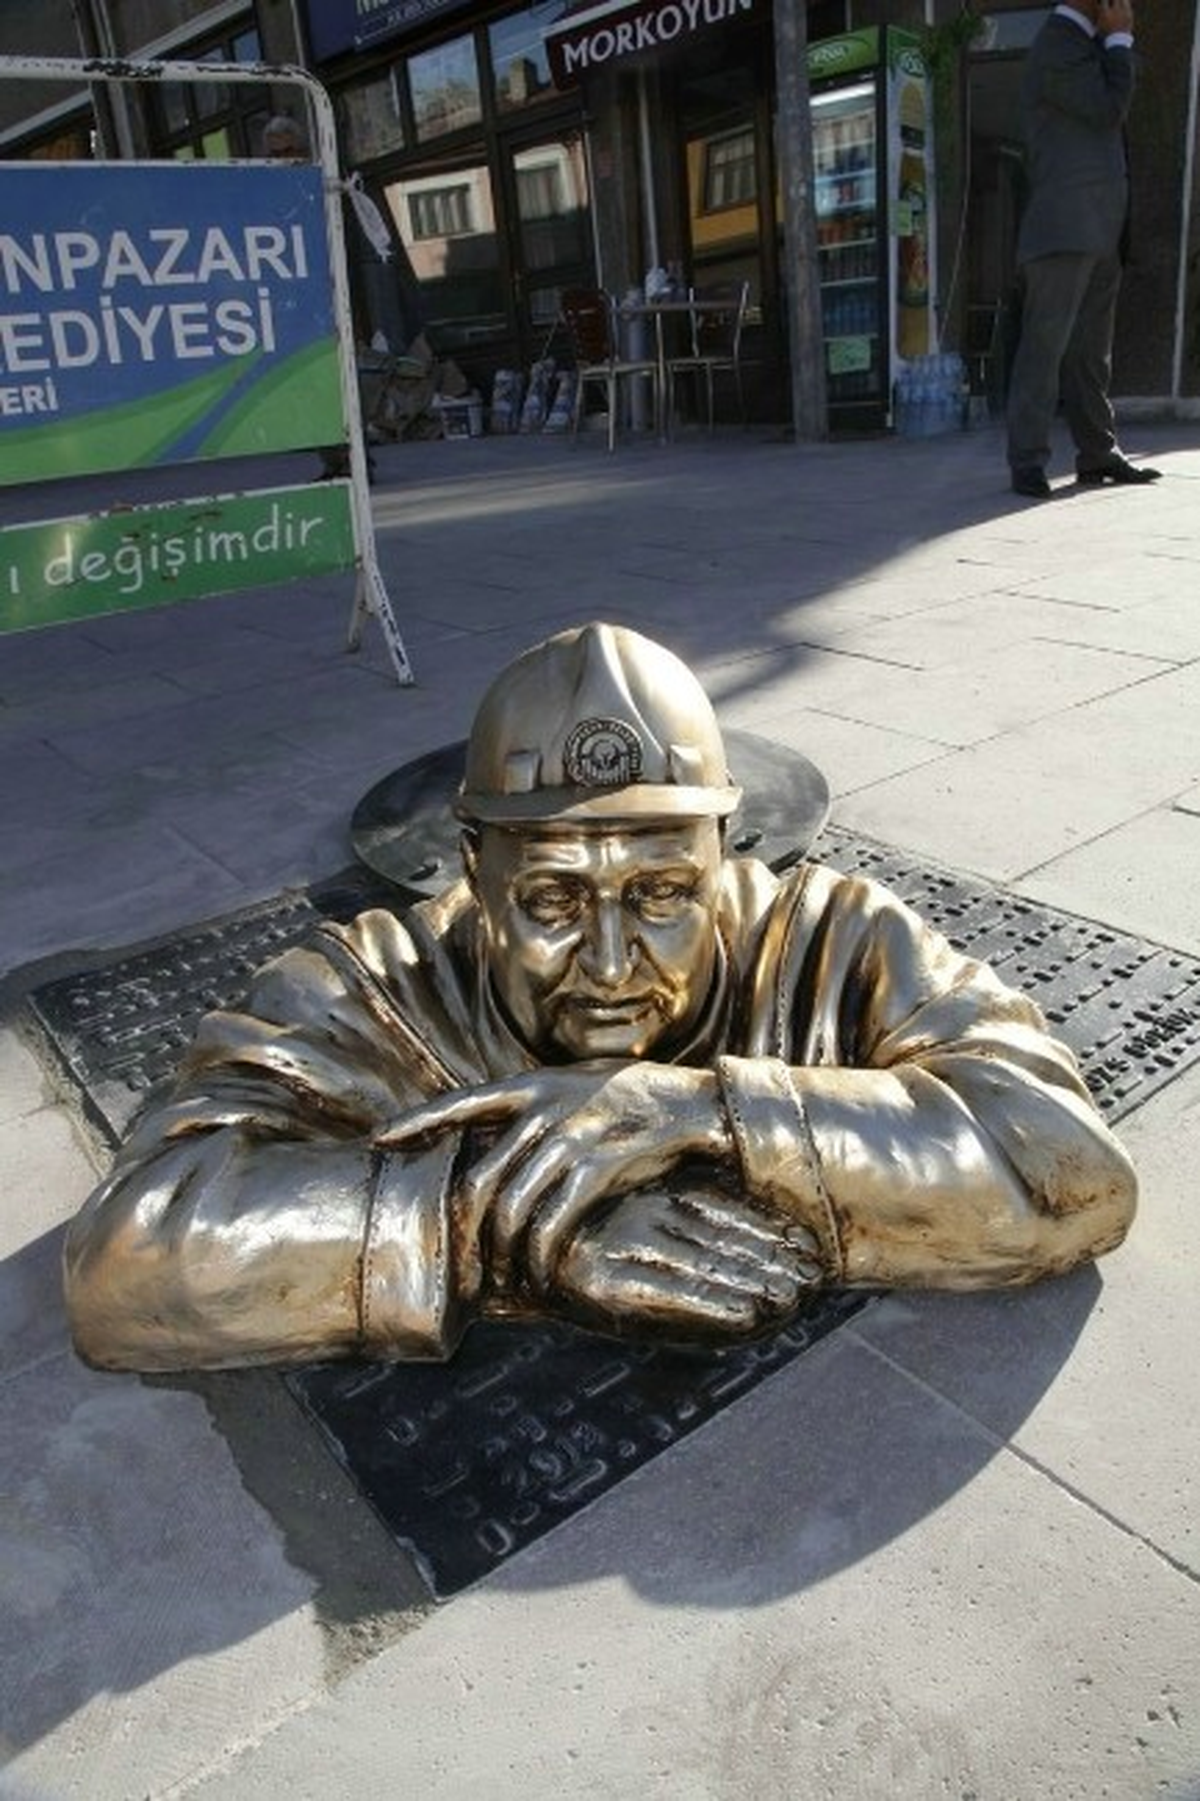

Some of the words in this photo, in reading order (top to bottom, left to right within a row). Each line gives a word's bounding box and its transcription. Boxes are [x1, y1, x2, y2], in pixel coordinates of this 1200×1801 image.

[0, 225, 309, 293] NPAZARI
[0, 287, 275, 373] EDİYESİ
[0, 377, 59, 415] ERİ
[44, 503, 323, 593] değişimdir
